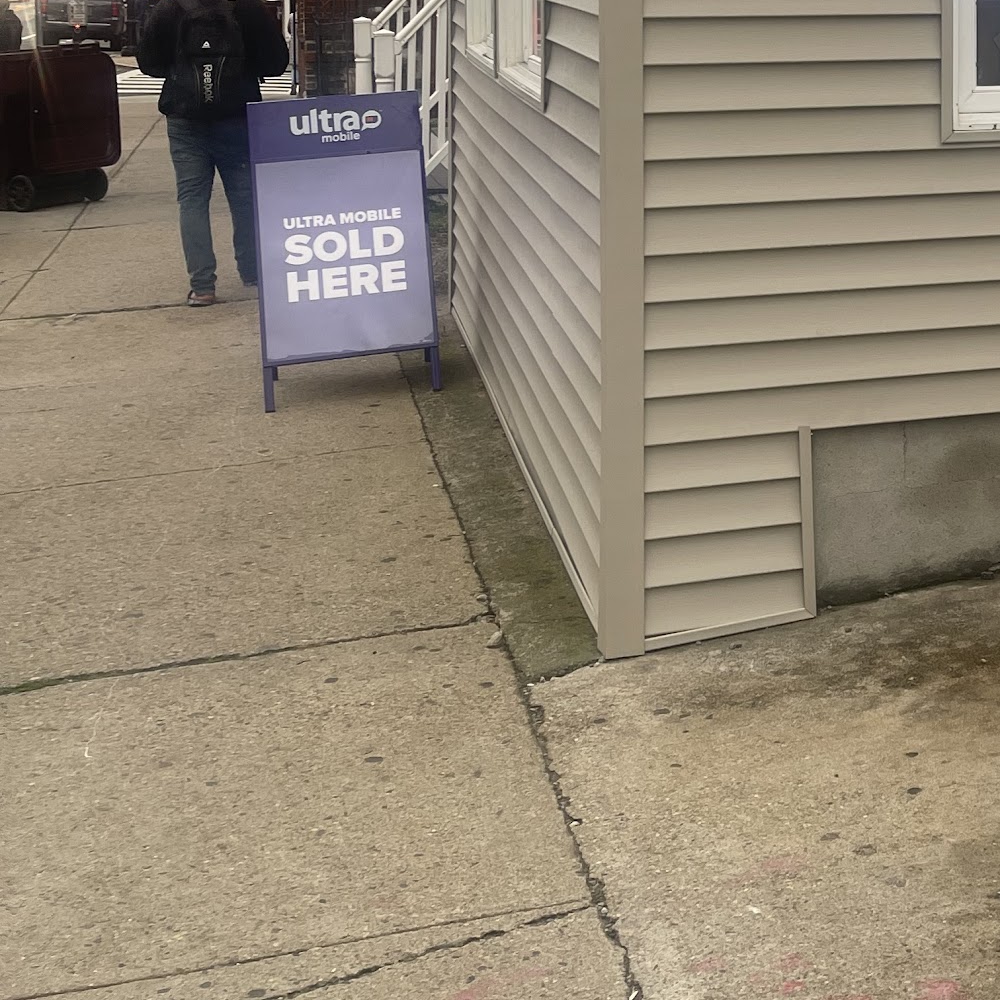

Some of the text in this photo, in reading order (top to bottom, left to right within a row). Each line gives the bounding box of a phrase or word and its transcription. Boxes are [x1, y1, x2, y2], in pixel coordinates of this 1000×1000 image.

[203, 64, 214, 103] Reebok
[289, 108, 361, 135] ultra
[321, 131, 361, 143] mobile
[283, 207, 402, 230] ULTRA MOBILE
[284, 225, 405, 266] SOLD
[286, 259, 408, 303] HERE
